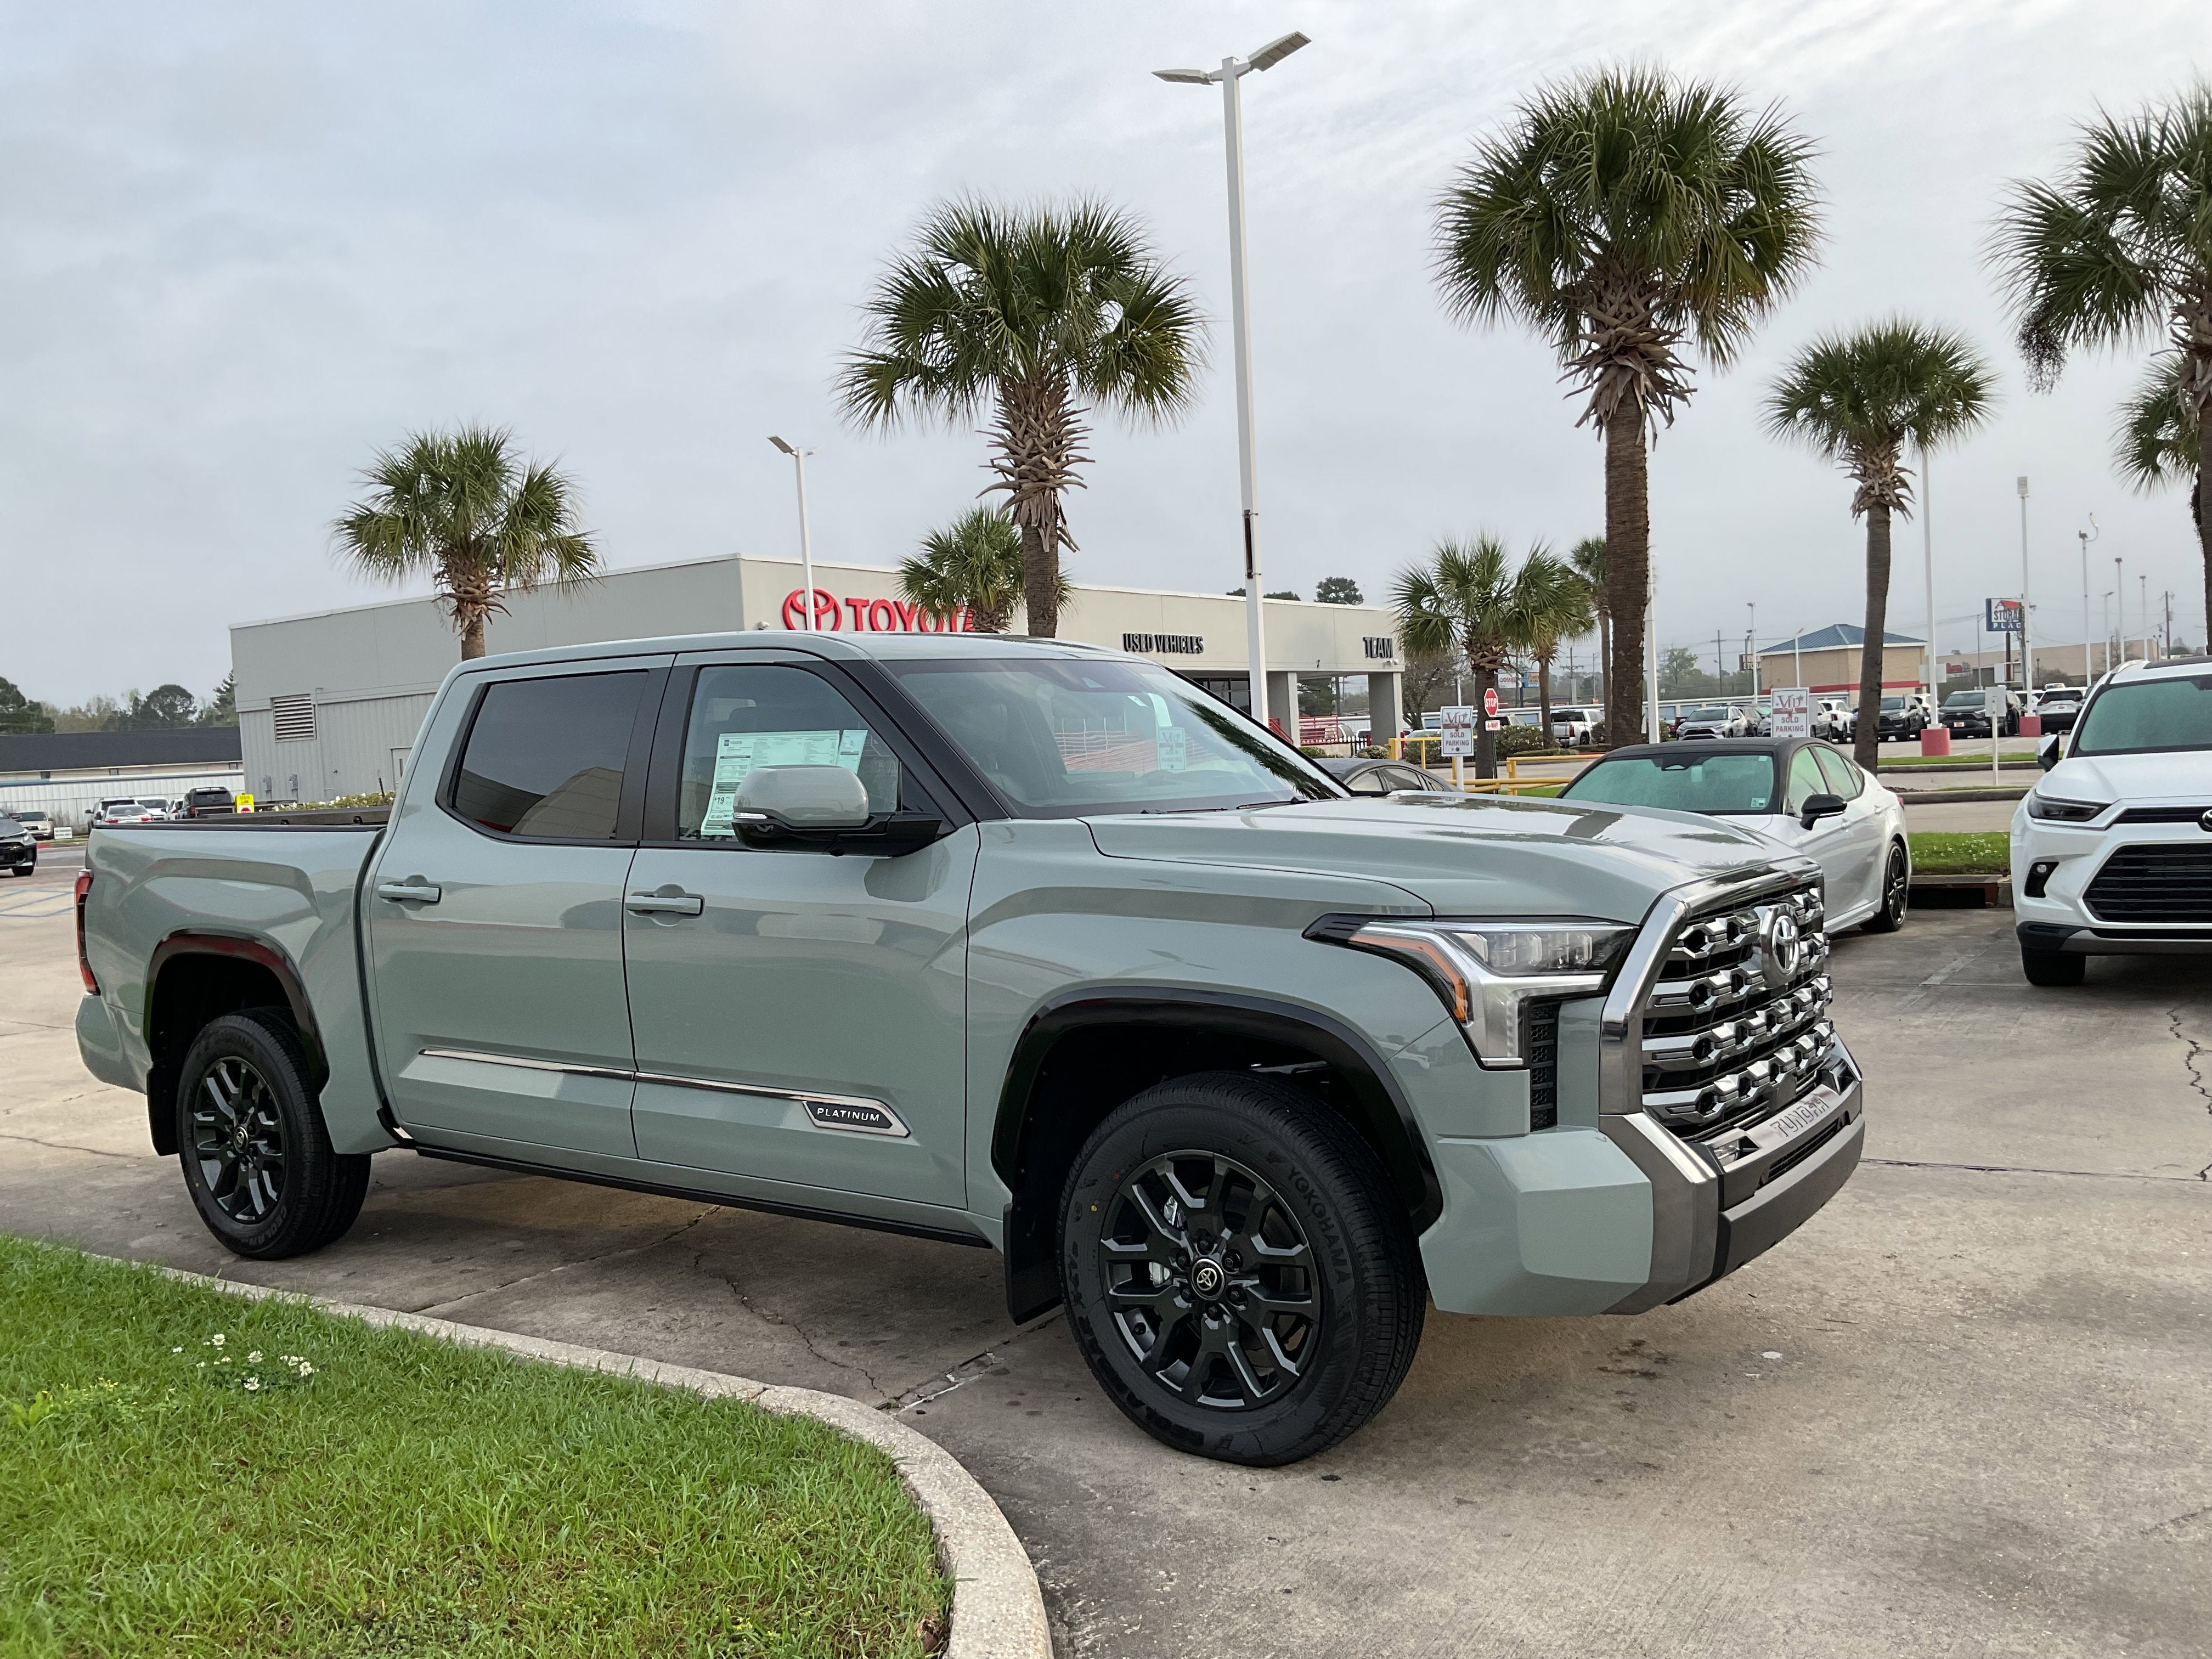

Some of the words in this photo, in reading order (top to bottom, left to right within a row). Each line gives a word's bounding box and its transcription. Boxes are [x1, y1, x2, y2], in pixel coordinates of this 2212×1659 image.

[1994, 610, 2019, 620] STORA
[1123, 633, 1154, 652] USED
[1154, 634, 1204, 653] VEHICLES
[1363, 637, 1393, 658] TEAM
[1485, 698, 1497, 708] STOP
[817, 1108, 879, 1121] PLATINUM
[1769, 1096, 1830, 1137] TUNDRA
[1289, 1166, 1353, 1284] YOKOHAMA
